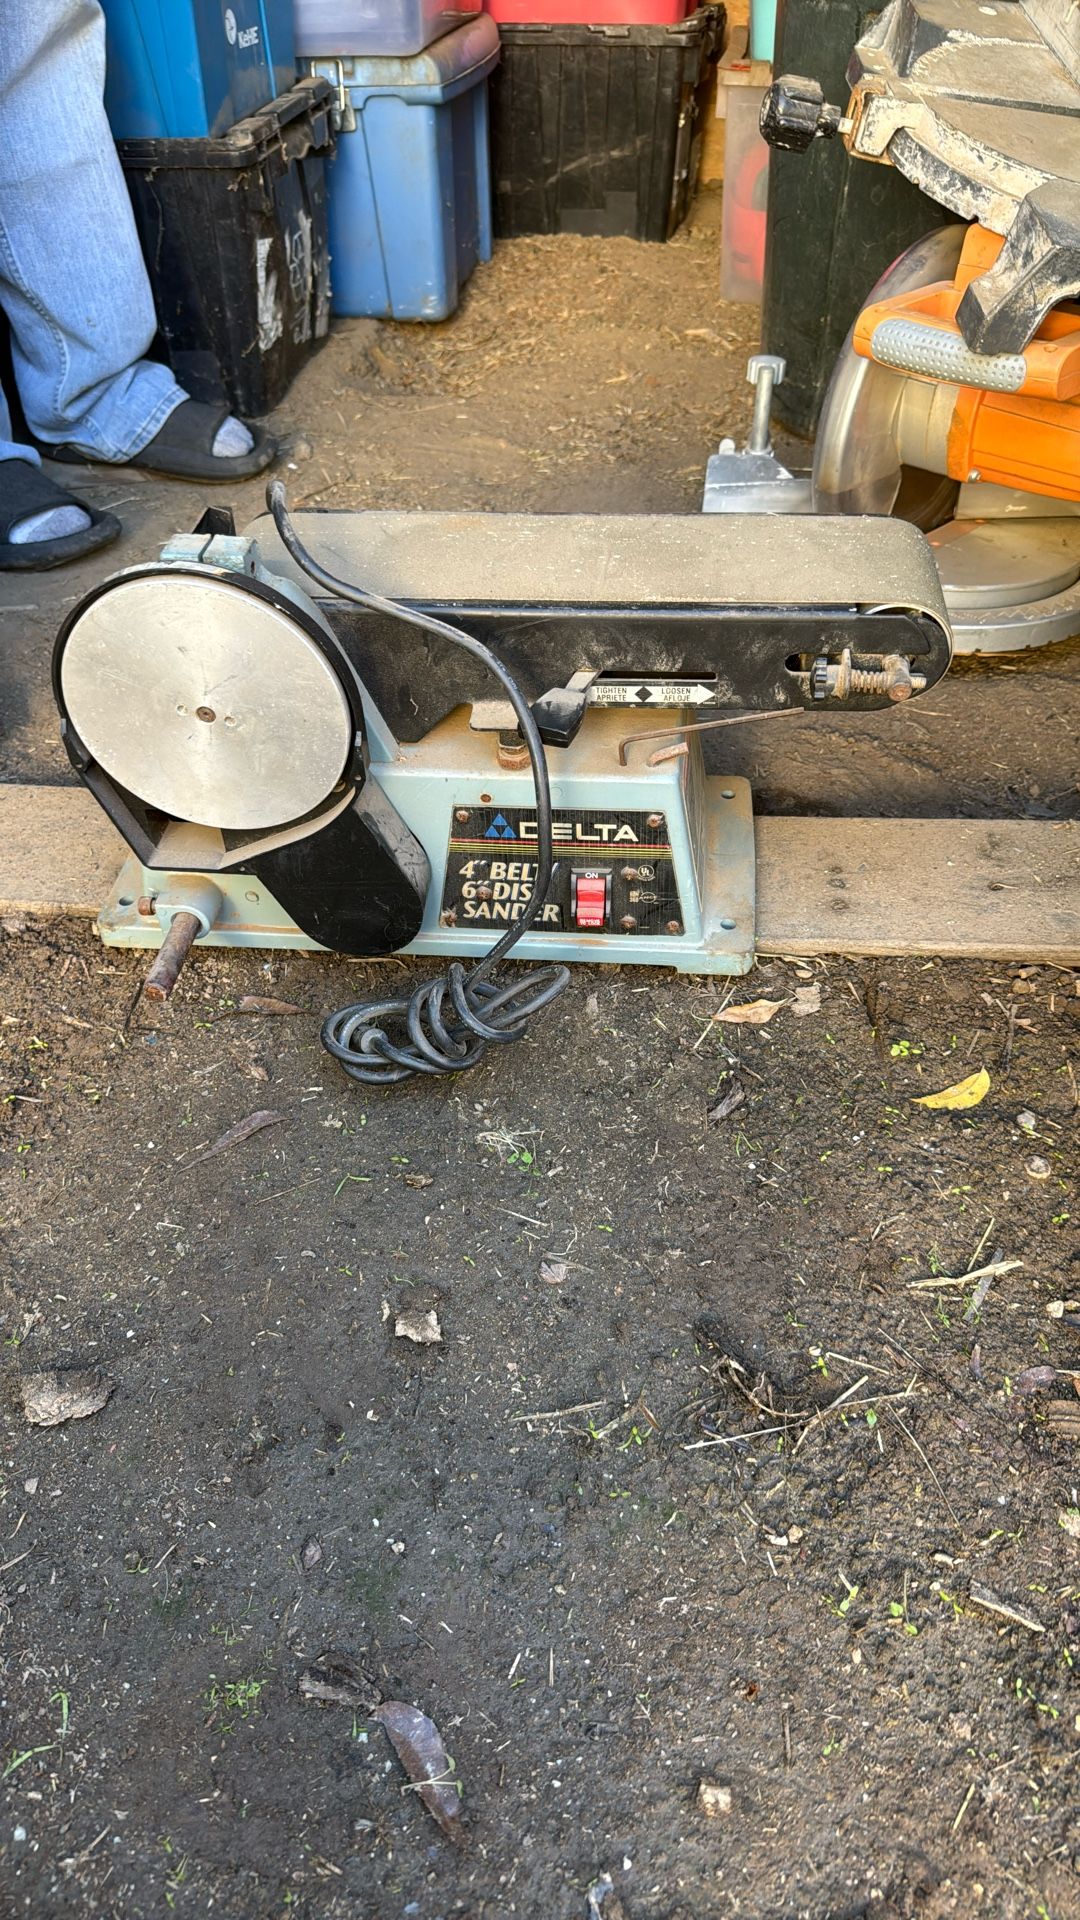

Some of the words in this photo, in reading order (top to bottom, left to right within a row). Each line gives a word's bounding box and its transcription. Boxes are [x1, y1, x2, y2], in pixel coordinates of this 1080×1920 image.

[596, 694, 627, 702] APRIETE
[663, 694, 691, 702] AFLOJE
[519, 821, 639, 842] DELTA
[492, 882, 533, 901] DIS
